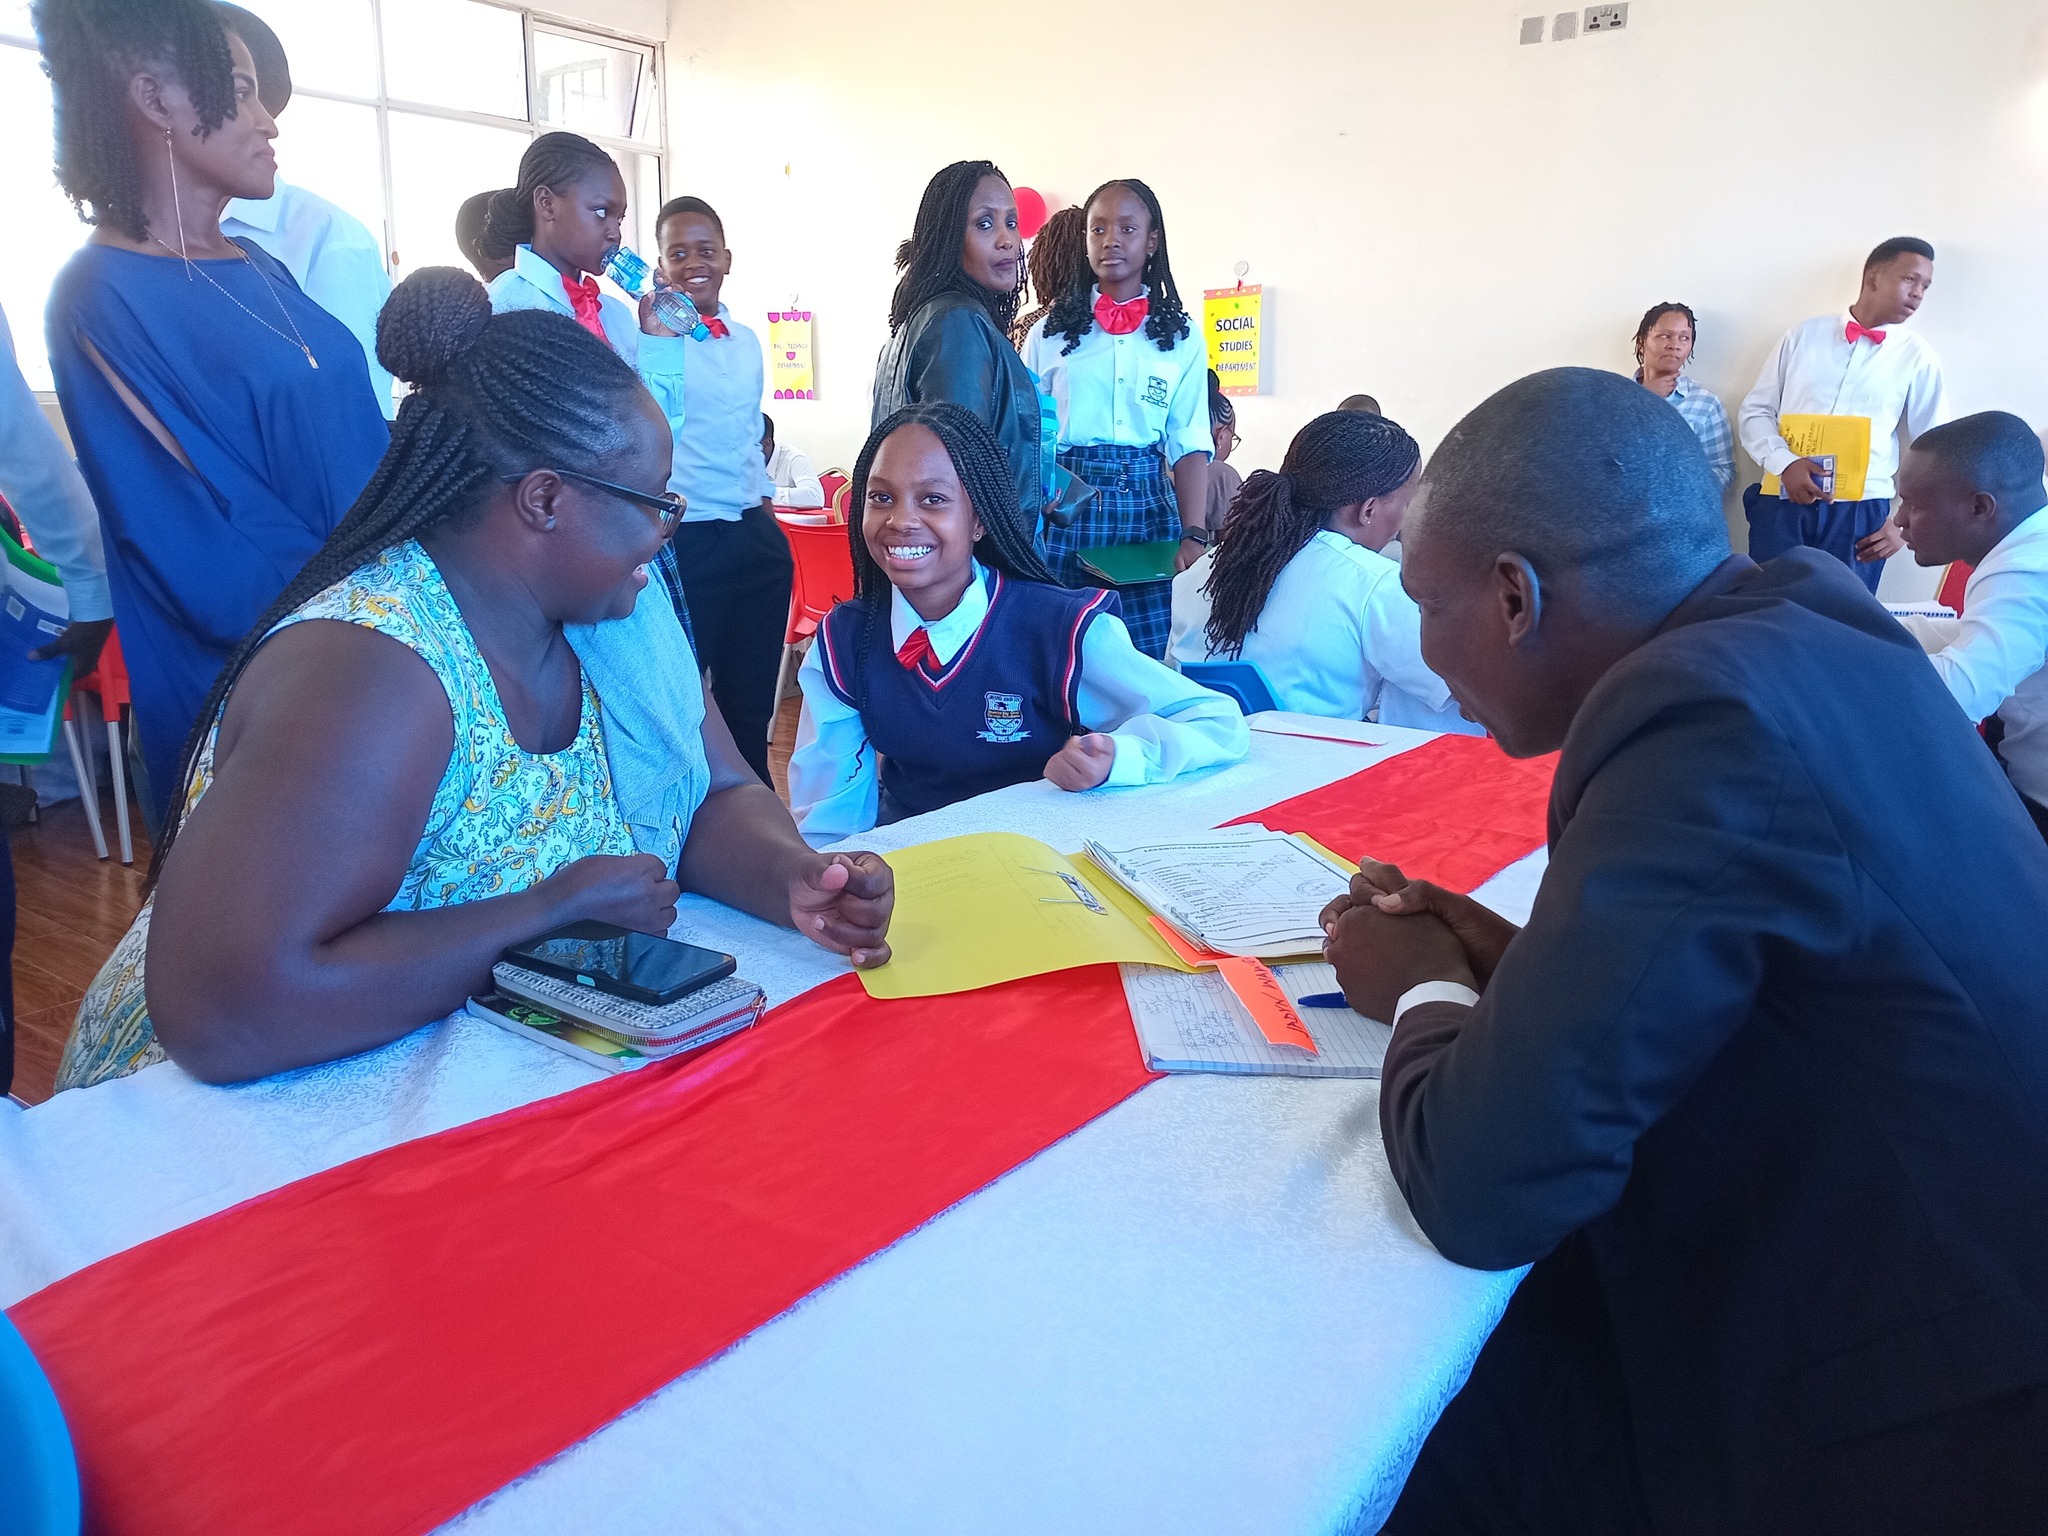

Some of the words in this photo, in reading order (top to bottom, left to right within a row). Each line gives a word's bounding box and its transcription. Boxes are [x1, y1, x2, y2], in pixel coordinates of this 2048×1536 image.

[1215, 316, 1255, 332] SOCIAL
[1219, 340, 1253, 352] STUDIES
[1215, 362, 1257, 372] DEPARTMENT
